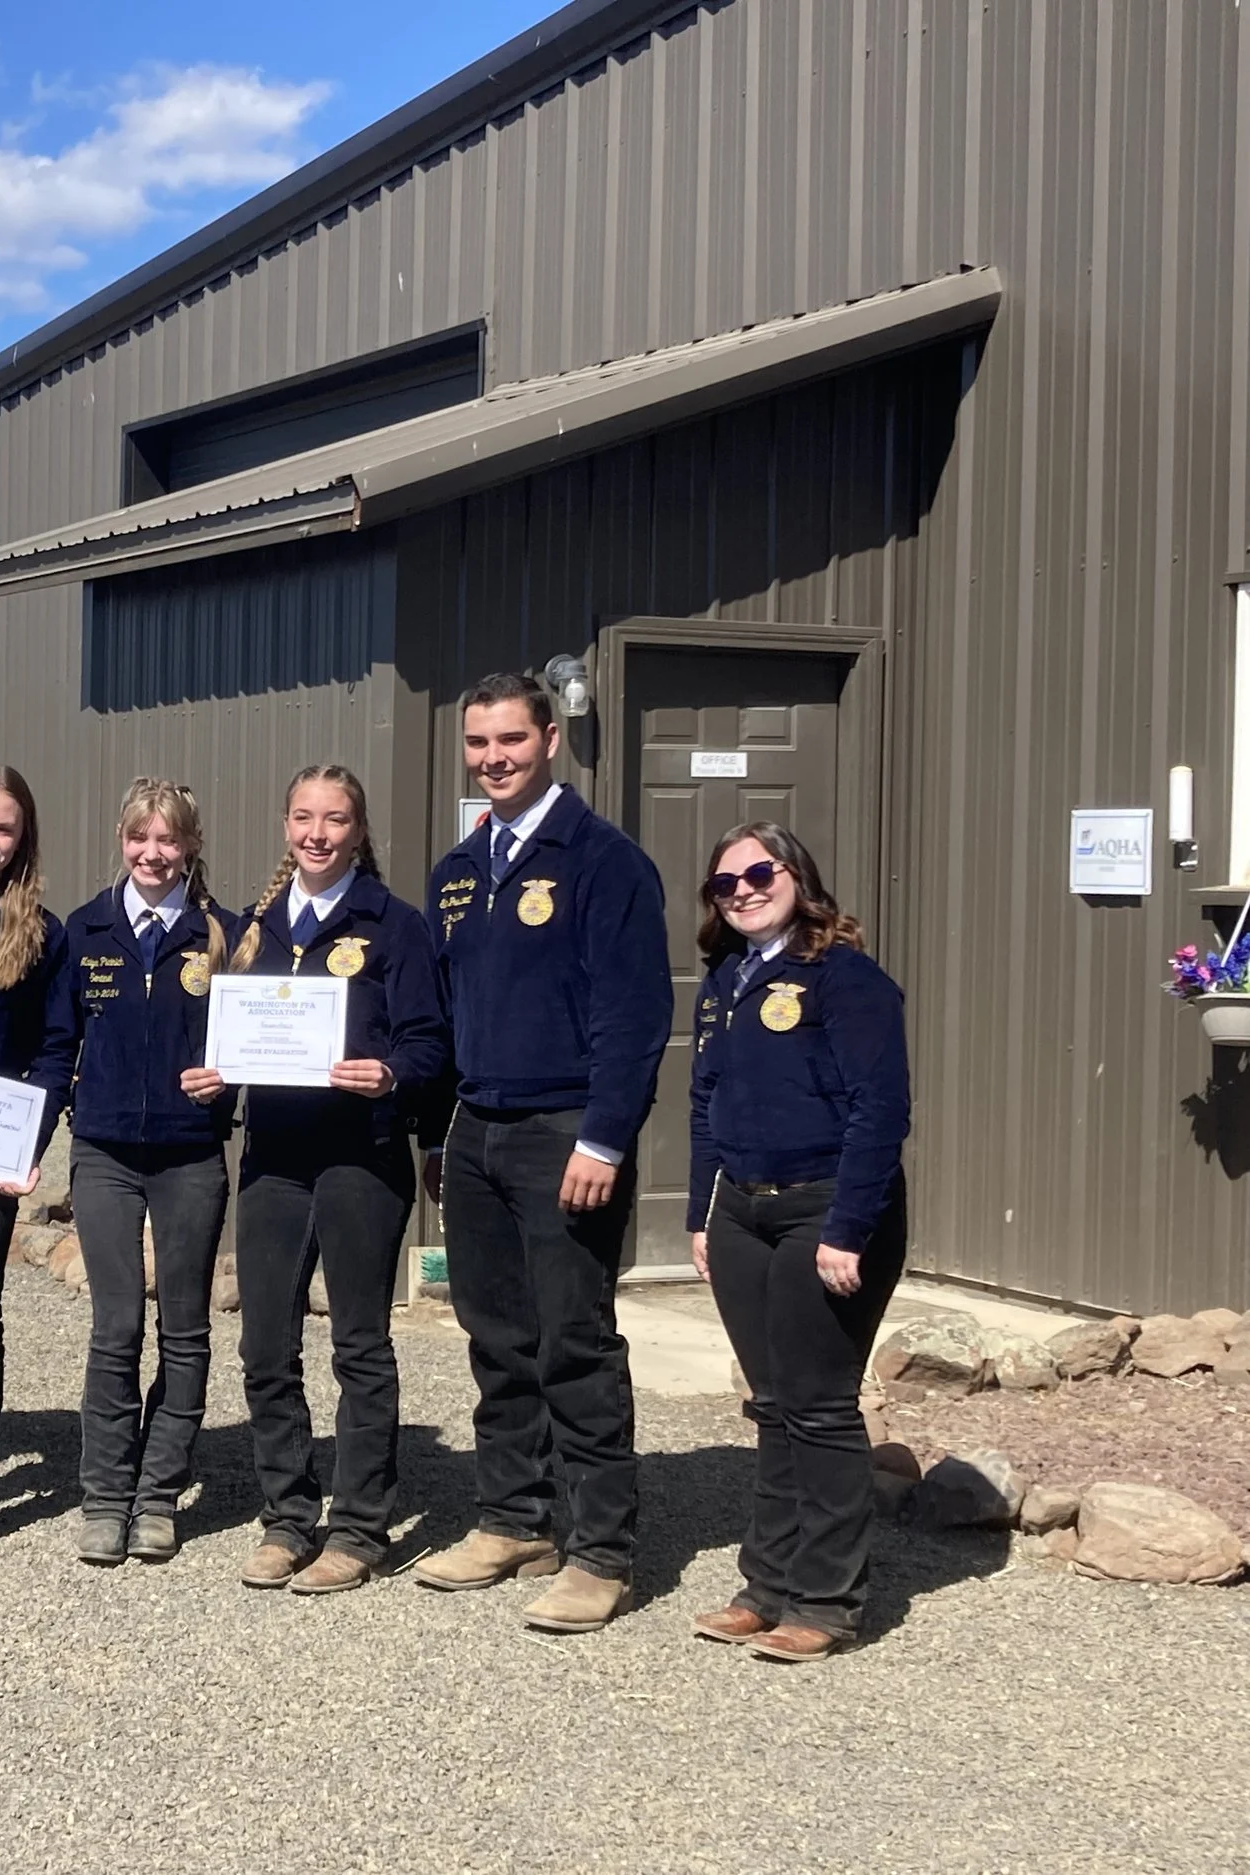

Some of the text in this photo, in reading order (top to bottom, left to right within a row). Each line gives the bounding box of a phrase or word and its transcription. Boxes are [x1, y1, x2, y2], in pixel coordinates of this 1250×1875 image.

[701, 755, 737, 764] OFFICE
[1095, 839, 1142, 858] AQHA
[238, 1000, 316, 1009] WASHINGTON FFA
[248, 1008, 305, 1016] ASSOCIATION
